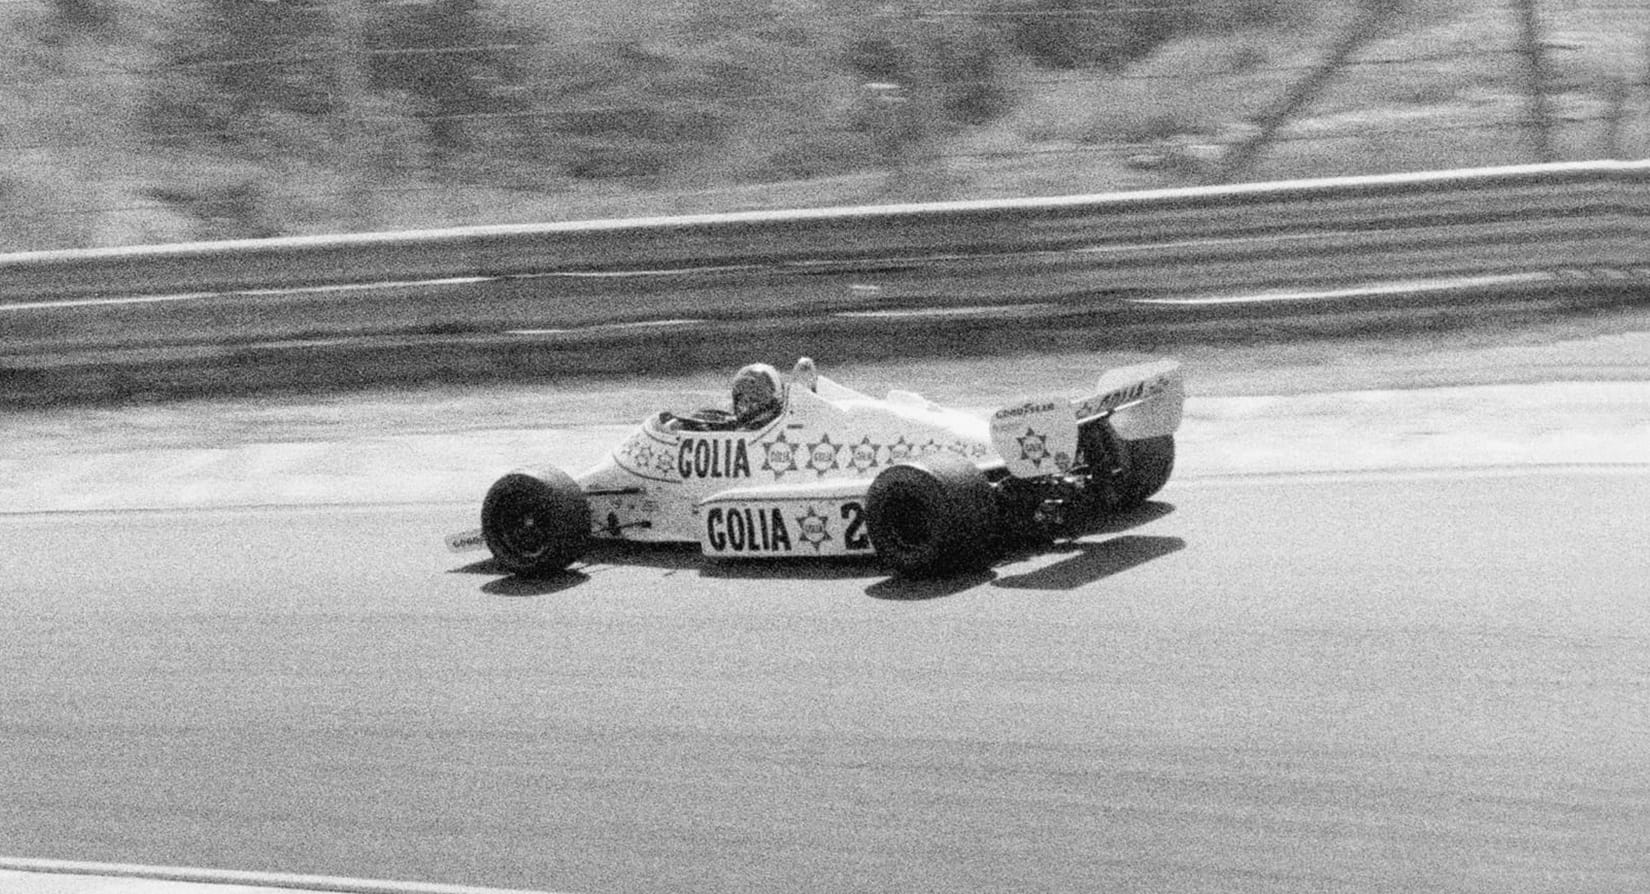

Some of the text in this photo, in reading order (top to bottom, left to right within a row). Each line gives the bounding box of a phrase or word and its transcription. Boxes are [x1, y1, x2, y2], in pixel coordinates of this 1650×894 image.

[678, 438, 750, 479] GOLIA
[707, 508, 791, 551] GOLIA
[840, 502, 871, 550] 2
